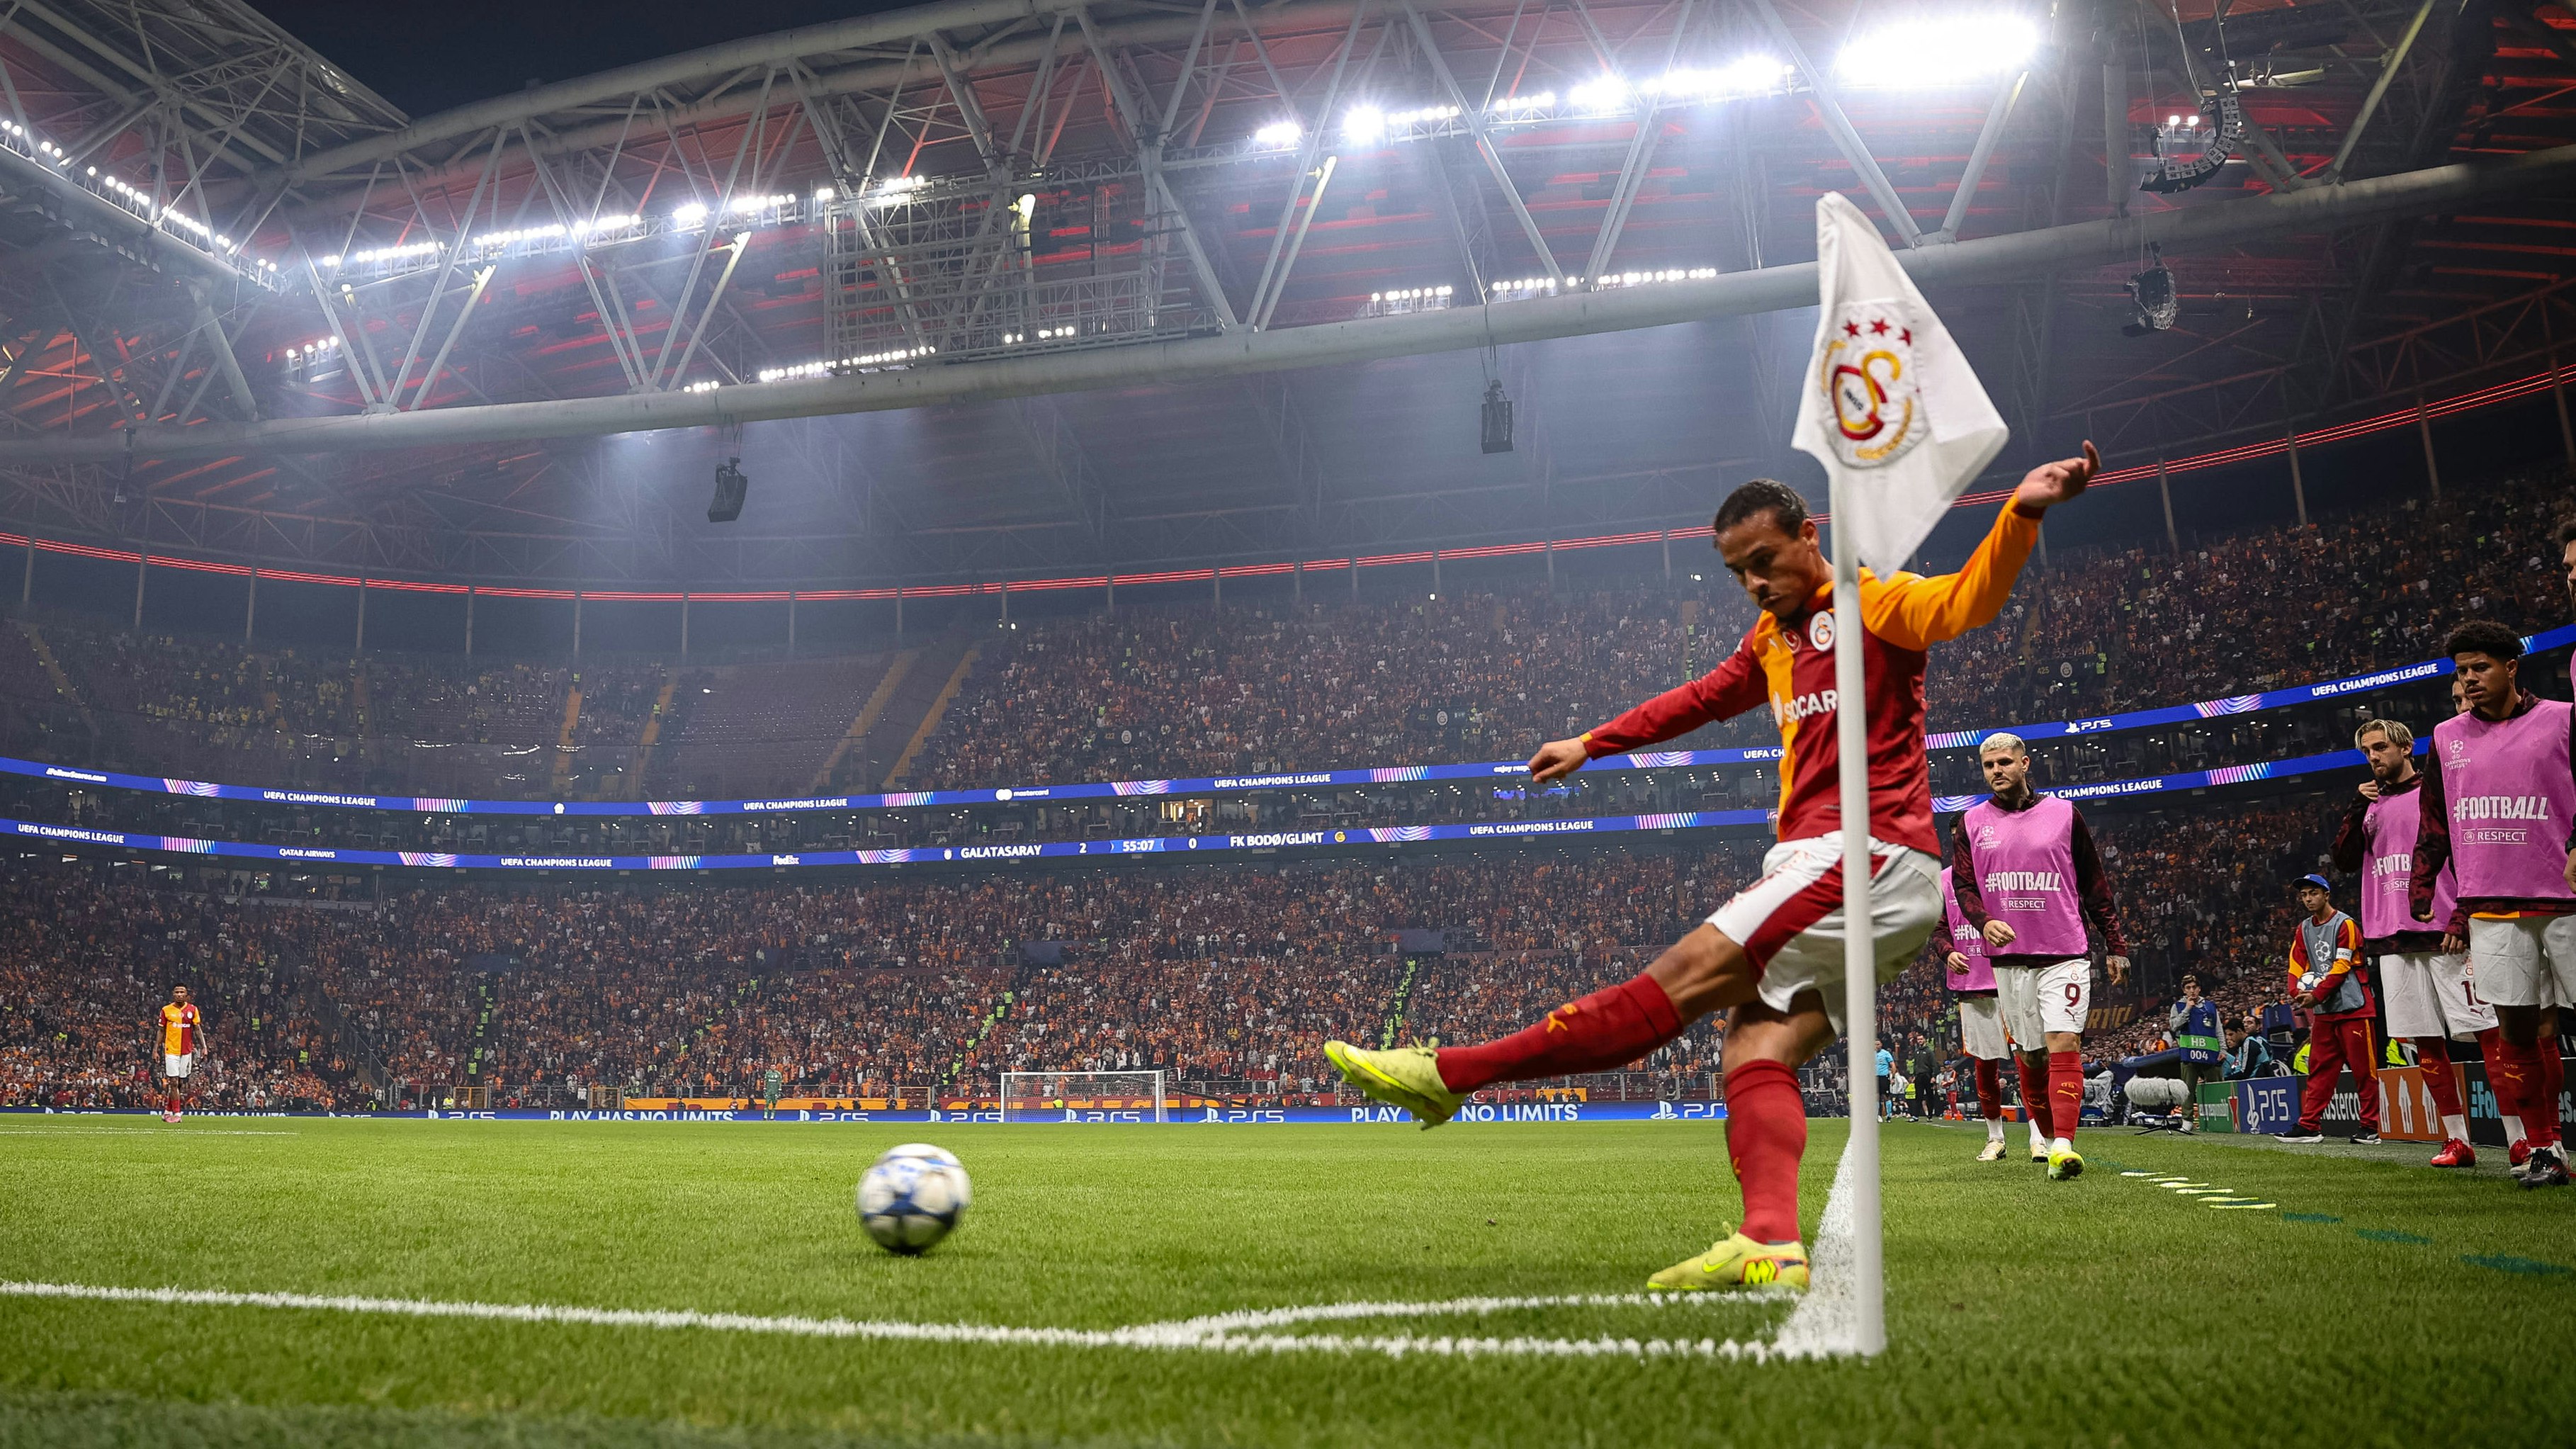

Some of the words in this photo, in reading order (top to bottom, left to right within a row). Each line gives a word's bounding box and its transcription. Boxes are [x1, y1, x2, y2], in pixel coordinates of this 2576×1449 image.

[2312, 684, 2338, 697] UEFA
[2339, 672, 2399, 692] CHAMPIONS
[2400, 663, 2439, 680] LEAGUE
[1784, 689, 1838, 723] SOCAR
[1744, 748, 1769, 759] UEFA
[1214, 779, 1238, 788] UEFA
[1239, 776, 1294, 786] CHAMPIONS
[1295, 774, 1331, 784] LEAGUE
[2058, 784, 2121, 799] CHAMPIONS
[2123, 779, 2162, 792] LEAGUE
[264, 791, 286, 800] UEFA
[287, 793, 341, 804] CHAMPIONS
[341, 797, 376, 806] LEAGUE
[743, 801, 764, 811] UEFA
[766, 799, 815, 809] CHAMPIONS
[815, 798, 847, 807] LEAGUE
[2453, 796, 2549, 822] #FOOTBALL
[18, 823, 38, 834] UEFA
[40, 827, 91, 840] CHAMPIONS
[91, 833, 124, 843] LEAGUE
[1470, 826, 1495, 835] UEFA
[1496, 823, 1554, 833] CHAMPIONS
[1556, 821, 1593, 830] LEAGUE
[1188, 838, 1197, 849] 0
[1230, 835, 1245, 847] FK
[1247, 832, 1325, 846] BODØ/GLIMT
[2477, 831, 2526, 842] RESPECT
[961, 845, 1042, 859] GALATASARAY
[1079, 843, 1087, 853] 2
[1122, 840, 1155, 852] 55:07
[501, 858, 524, 867] UEFA
[2371, 852, 2412, 879] #FOOTB
[1985, 872, 2061, 893] #FOOTBALL
[2009, 900, 2045, 908] RESPECT
[2064, 983, 2081, 1007] 9
[2191, 1037, 2207, 1047] HB
[2189, 1049, 2209, 1061] 004
[1683, 1103, 1729, 1118] PS
[2258, 1088, 2289, 1122] PS5
[1351, 1106, 1401, 1122] PLAY
[1461, 1105, 1496, 1122] NO
[1503, 1104, 1578, 1122] LIMITS
